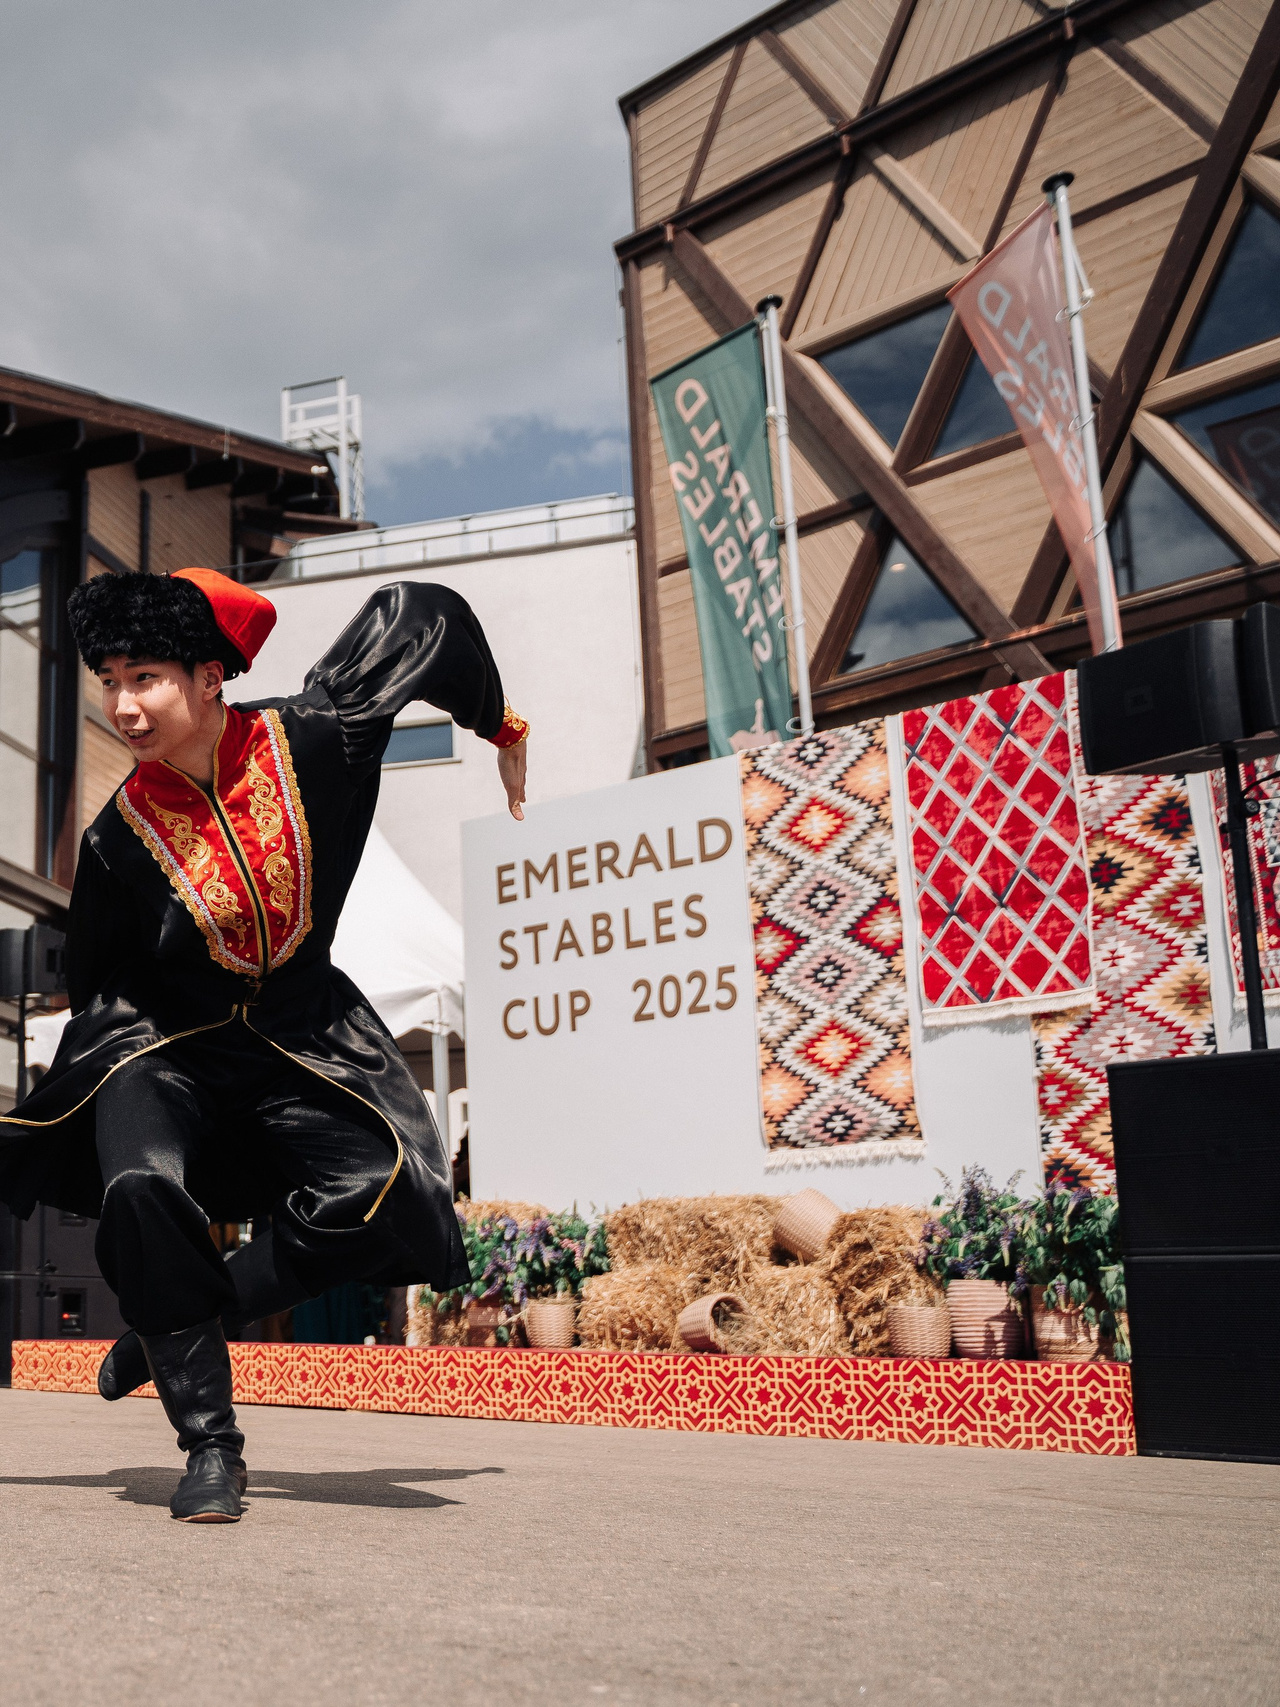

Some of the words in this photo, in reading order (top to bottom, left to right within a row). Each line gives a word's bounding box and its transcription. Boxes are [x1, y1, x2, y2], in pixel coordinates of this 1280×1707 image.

[496, 817, 733, 904] EMERALD
[499, 894, 707, 970] STABLES
[502, 989, 592, 1040] CUP
[632, 965, 737, 1023] 2025
